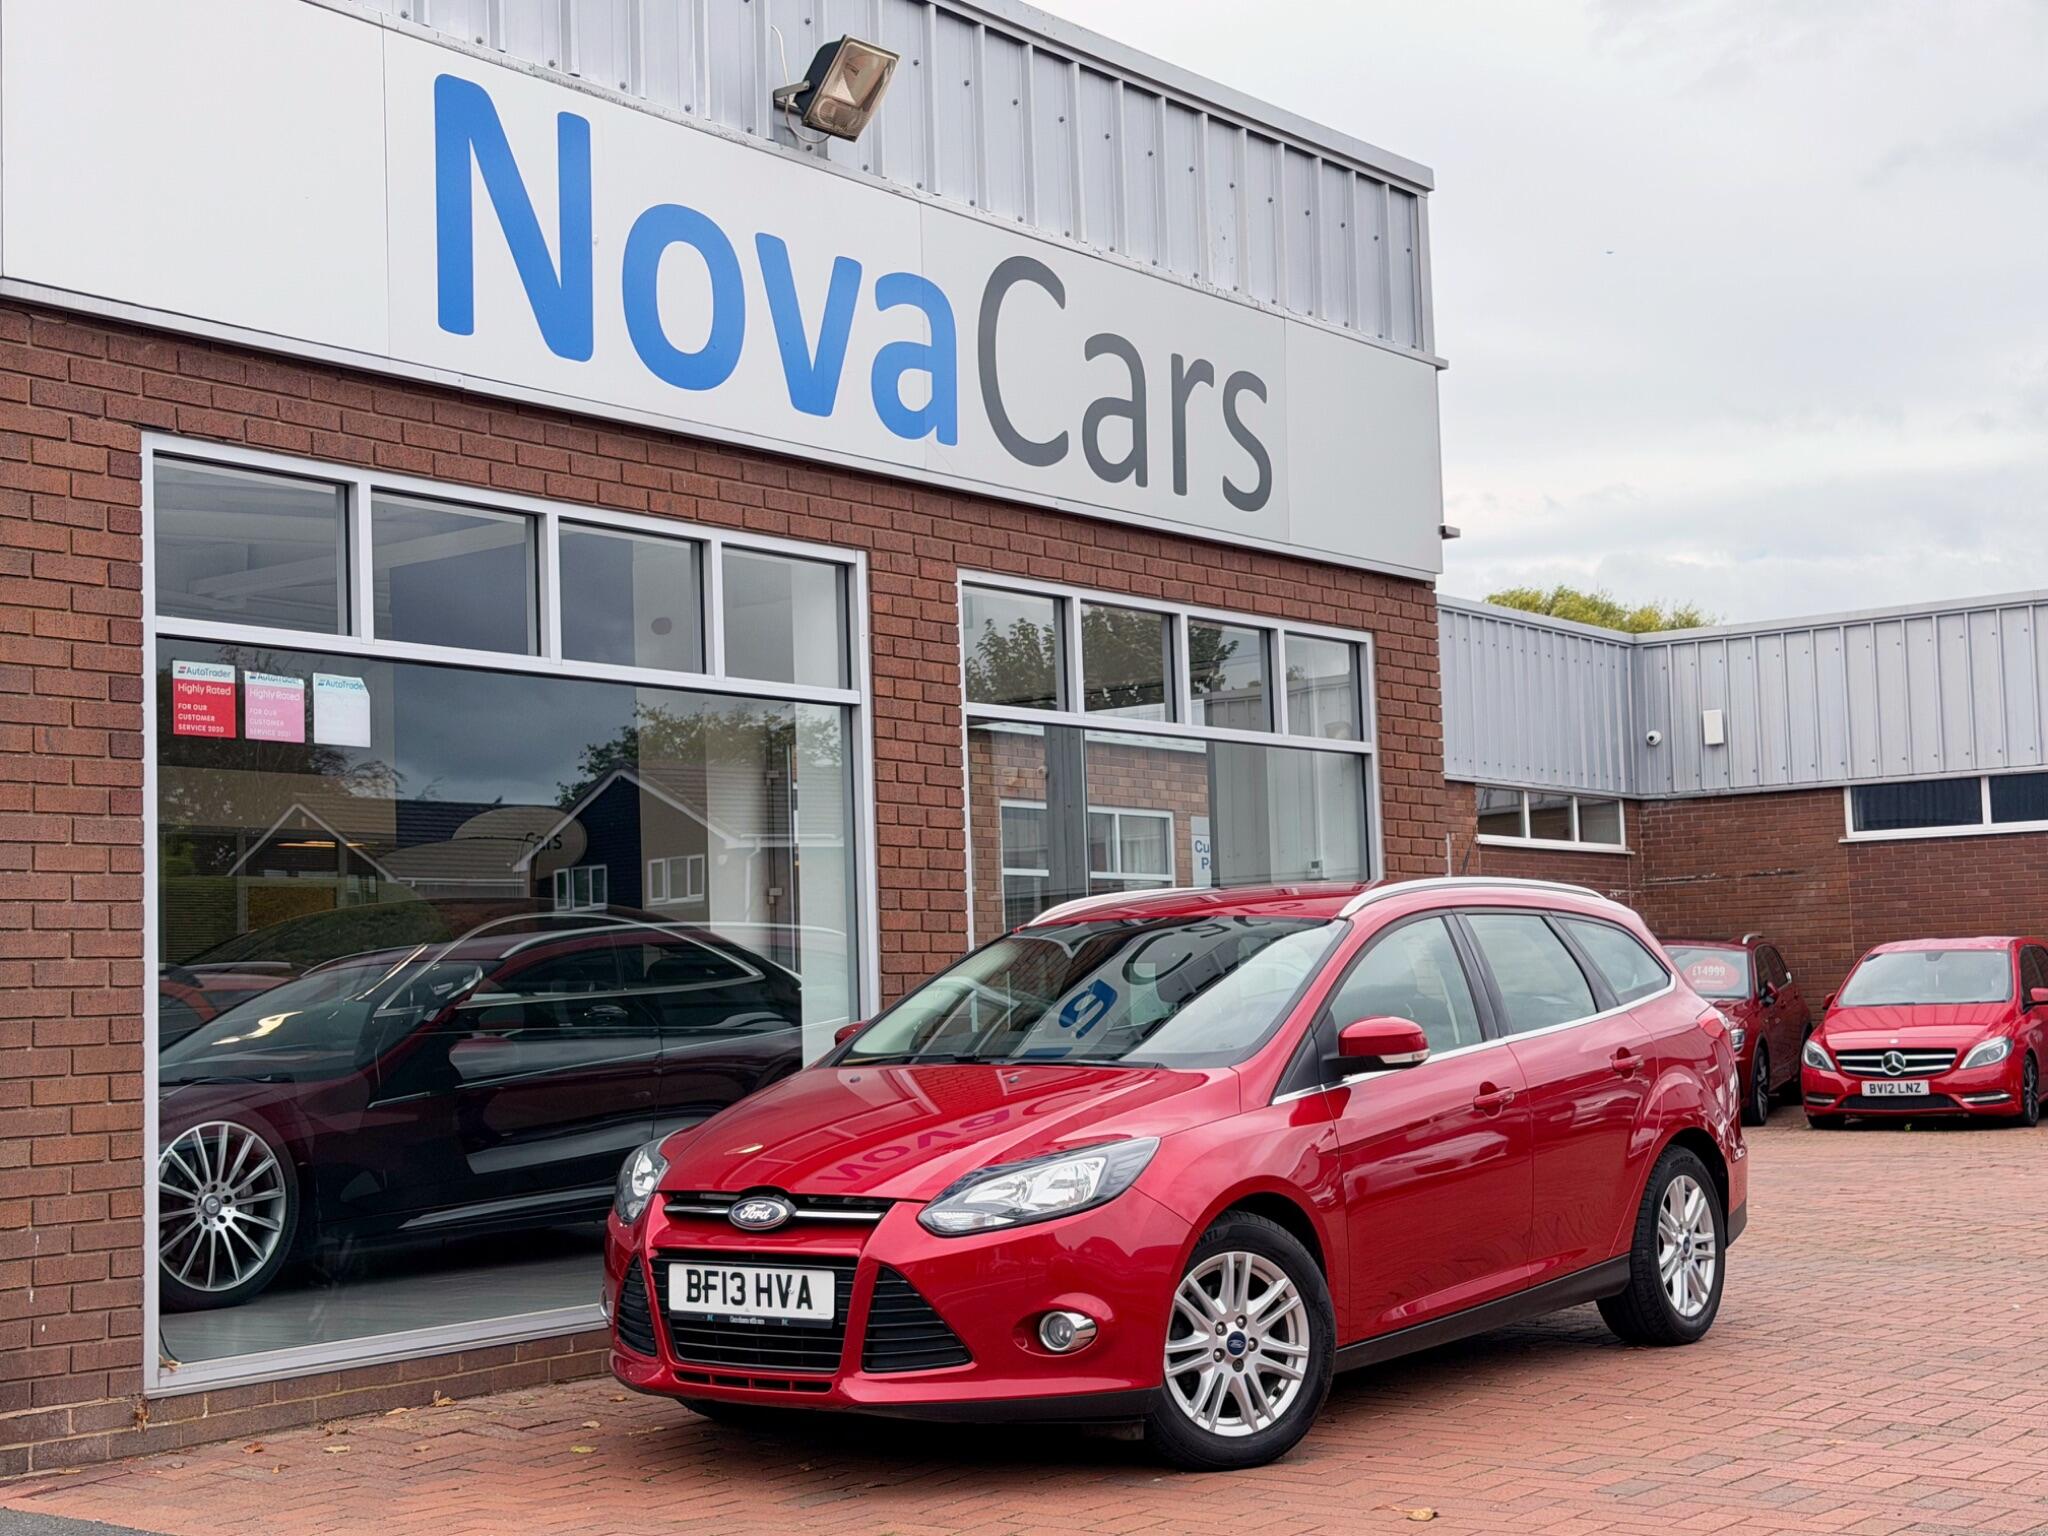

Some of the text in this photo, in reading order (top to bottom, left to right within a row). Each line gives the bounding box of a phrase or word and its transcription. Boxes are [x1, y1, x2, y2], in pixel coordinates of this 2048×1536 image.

[434, 73, 1273, 512] NovaCars
[186, 667, 231, 678] AutoTrader
[177, 683, 232, 696] Highly Rated
[325, 679, 364, 690] AutoTrade
[249, 687, 300, 701] Highly Rated
[177, 703, 192, 711] FOR
[177, 713, 215, 722] CUSTOMER
[177, 724, 207, 733] SERVICE
[1201, 856, 1210, 870] P
[1869, 1082, 1922, 1094] BV12 LNZ
[740, 1203, 770, 1220] Ford
[686, 1269, 813, 1310] BF13 HVA
